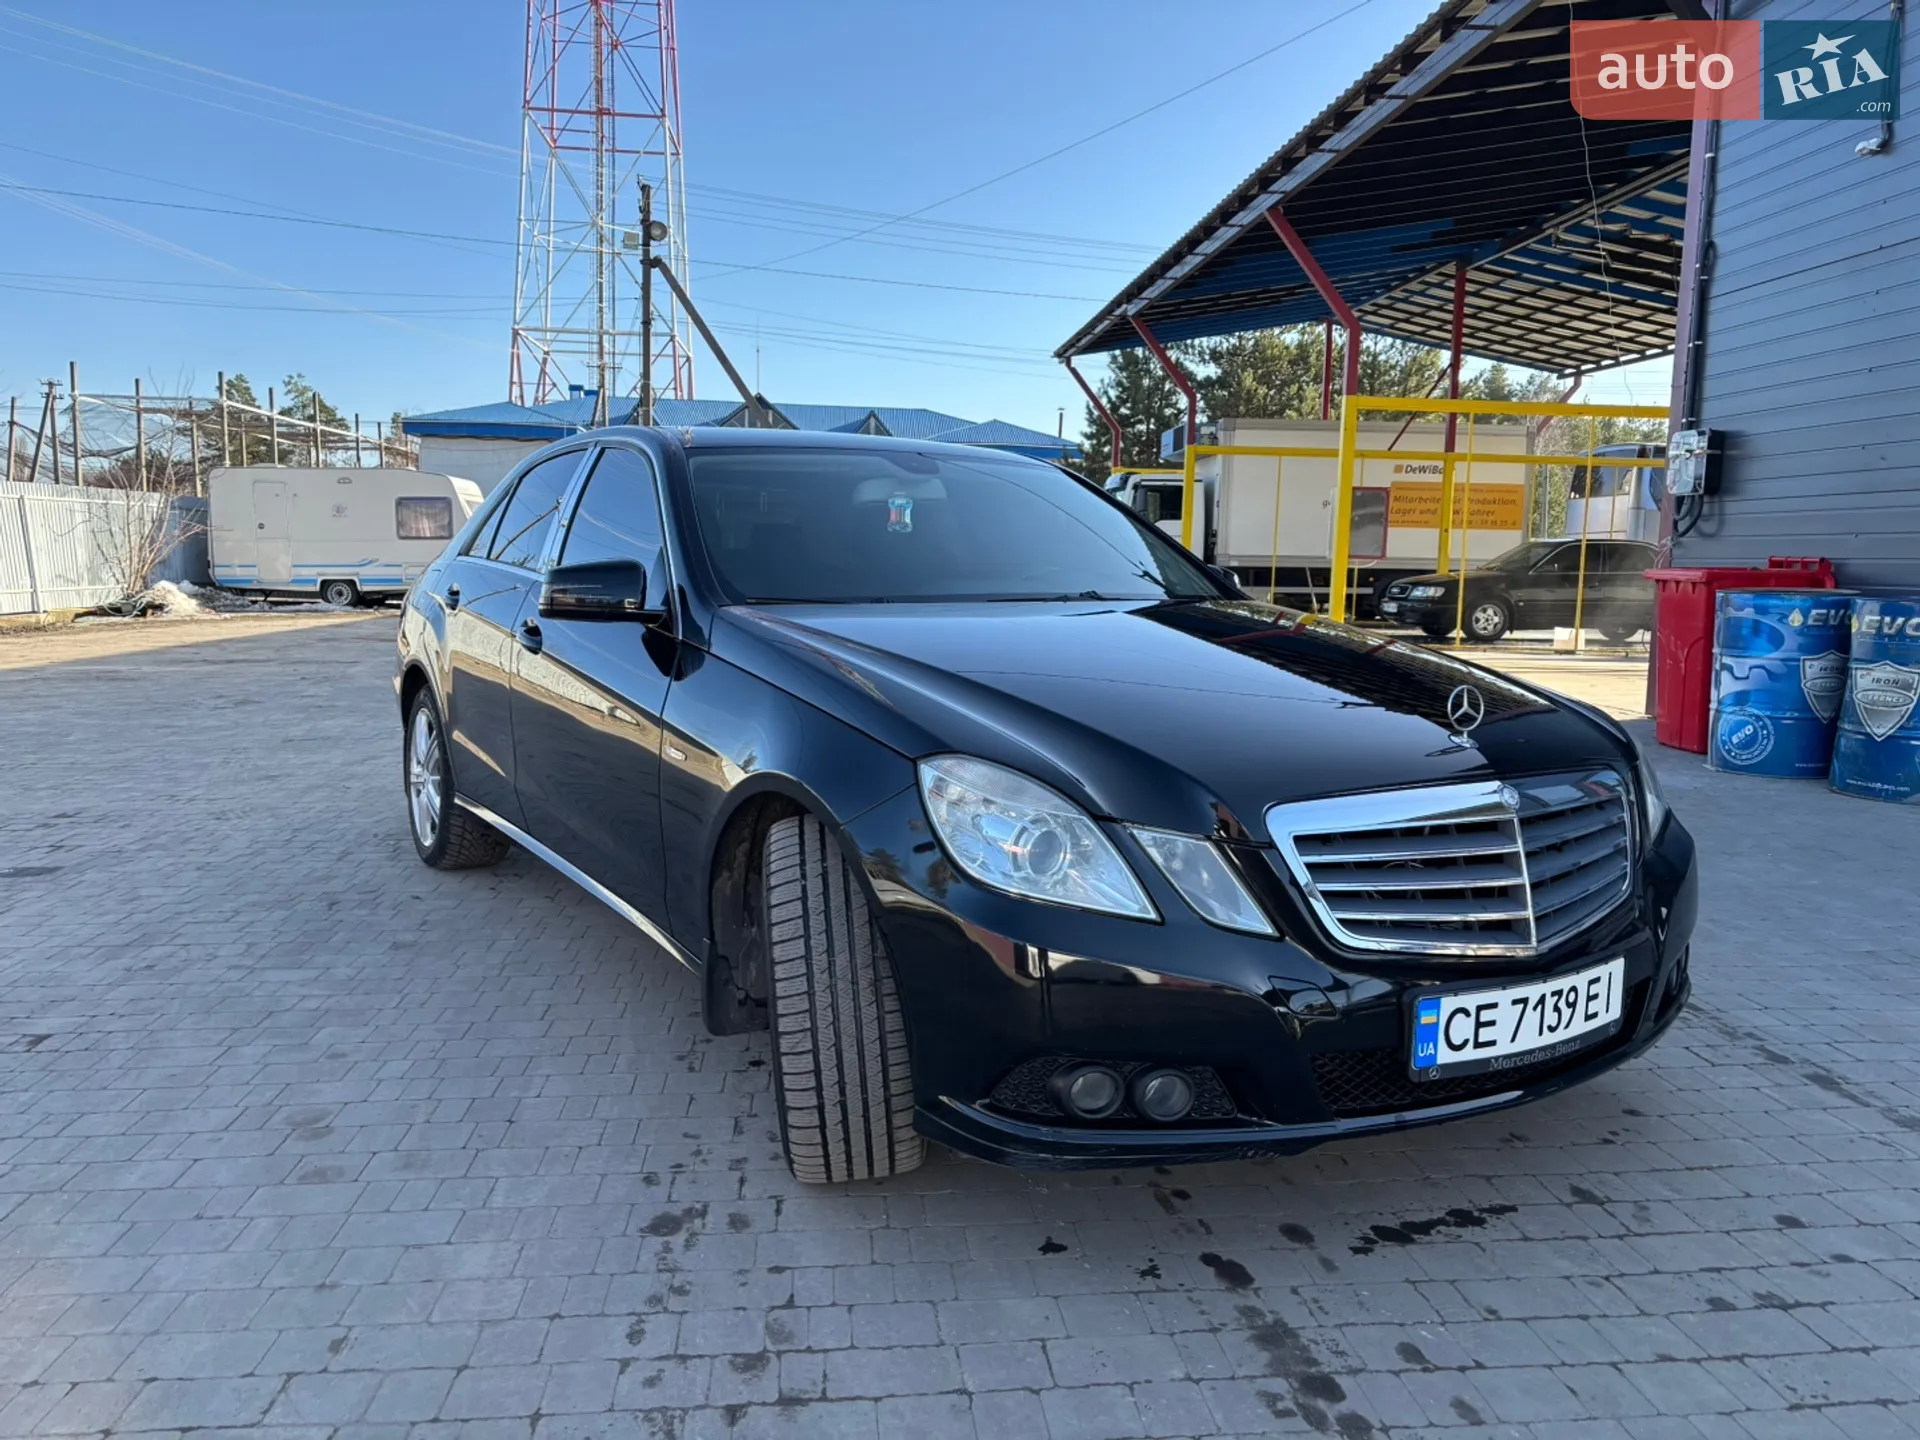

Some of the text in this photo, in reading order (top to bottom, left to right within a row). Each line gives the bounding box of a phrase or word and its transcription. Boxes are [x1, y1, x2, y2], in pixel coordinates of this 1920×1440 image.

[1393, 496, 1442, 504] Mitarbeite
[1468, 497, 1518, 506] roduktion,
[1390, 507, 1416, 517] Lager
[1807, 609, 1851, 626] EV
[1871, 677, 1900, 686] IRON
[1731, 724, 1754, 744] EVO
[1444, 971, 1612, 1052] CE 7139 EI
[1418, 1042, 1436, 1057] UA
[1489, 1039, 1581, 1072] Mercedes-Benz
